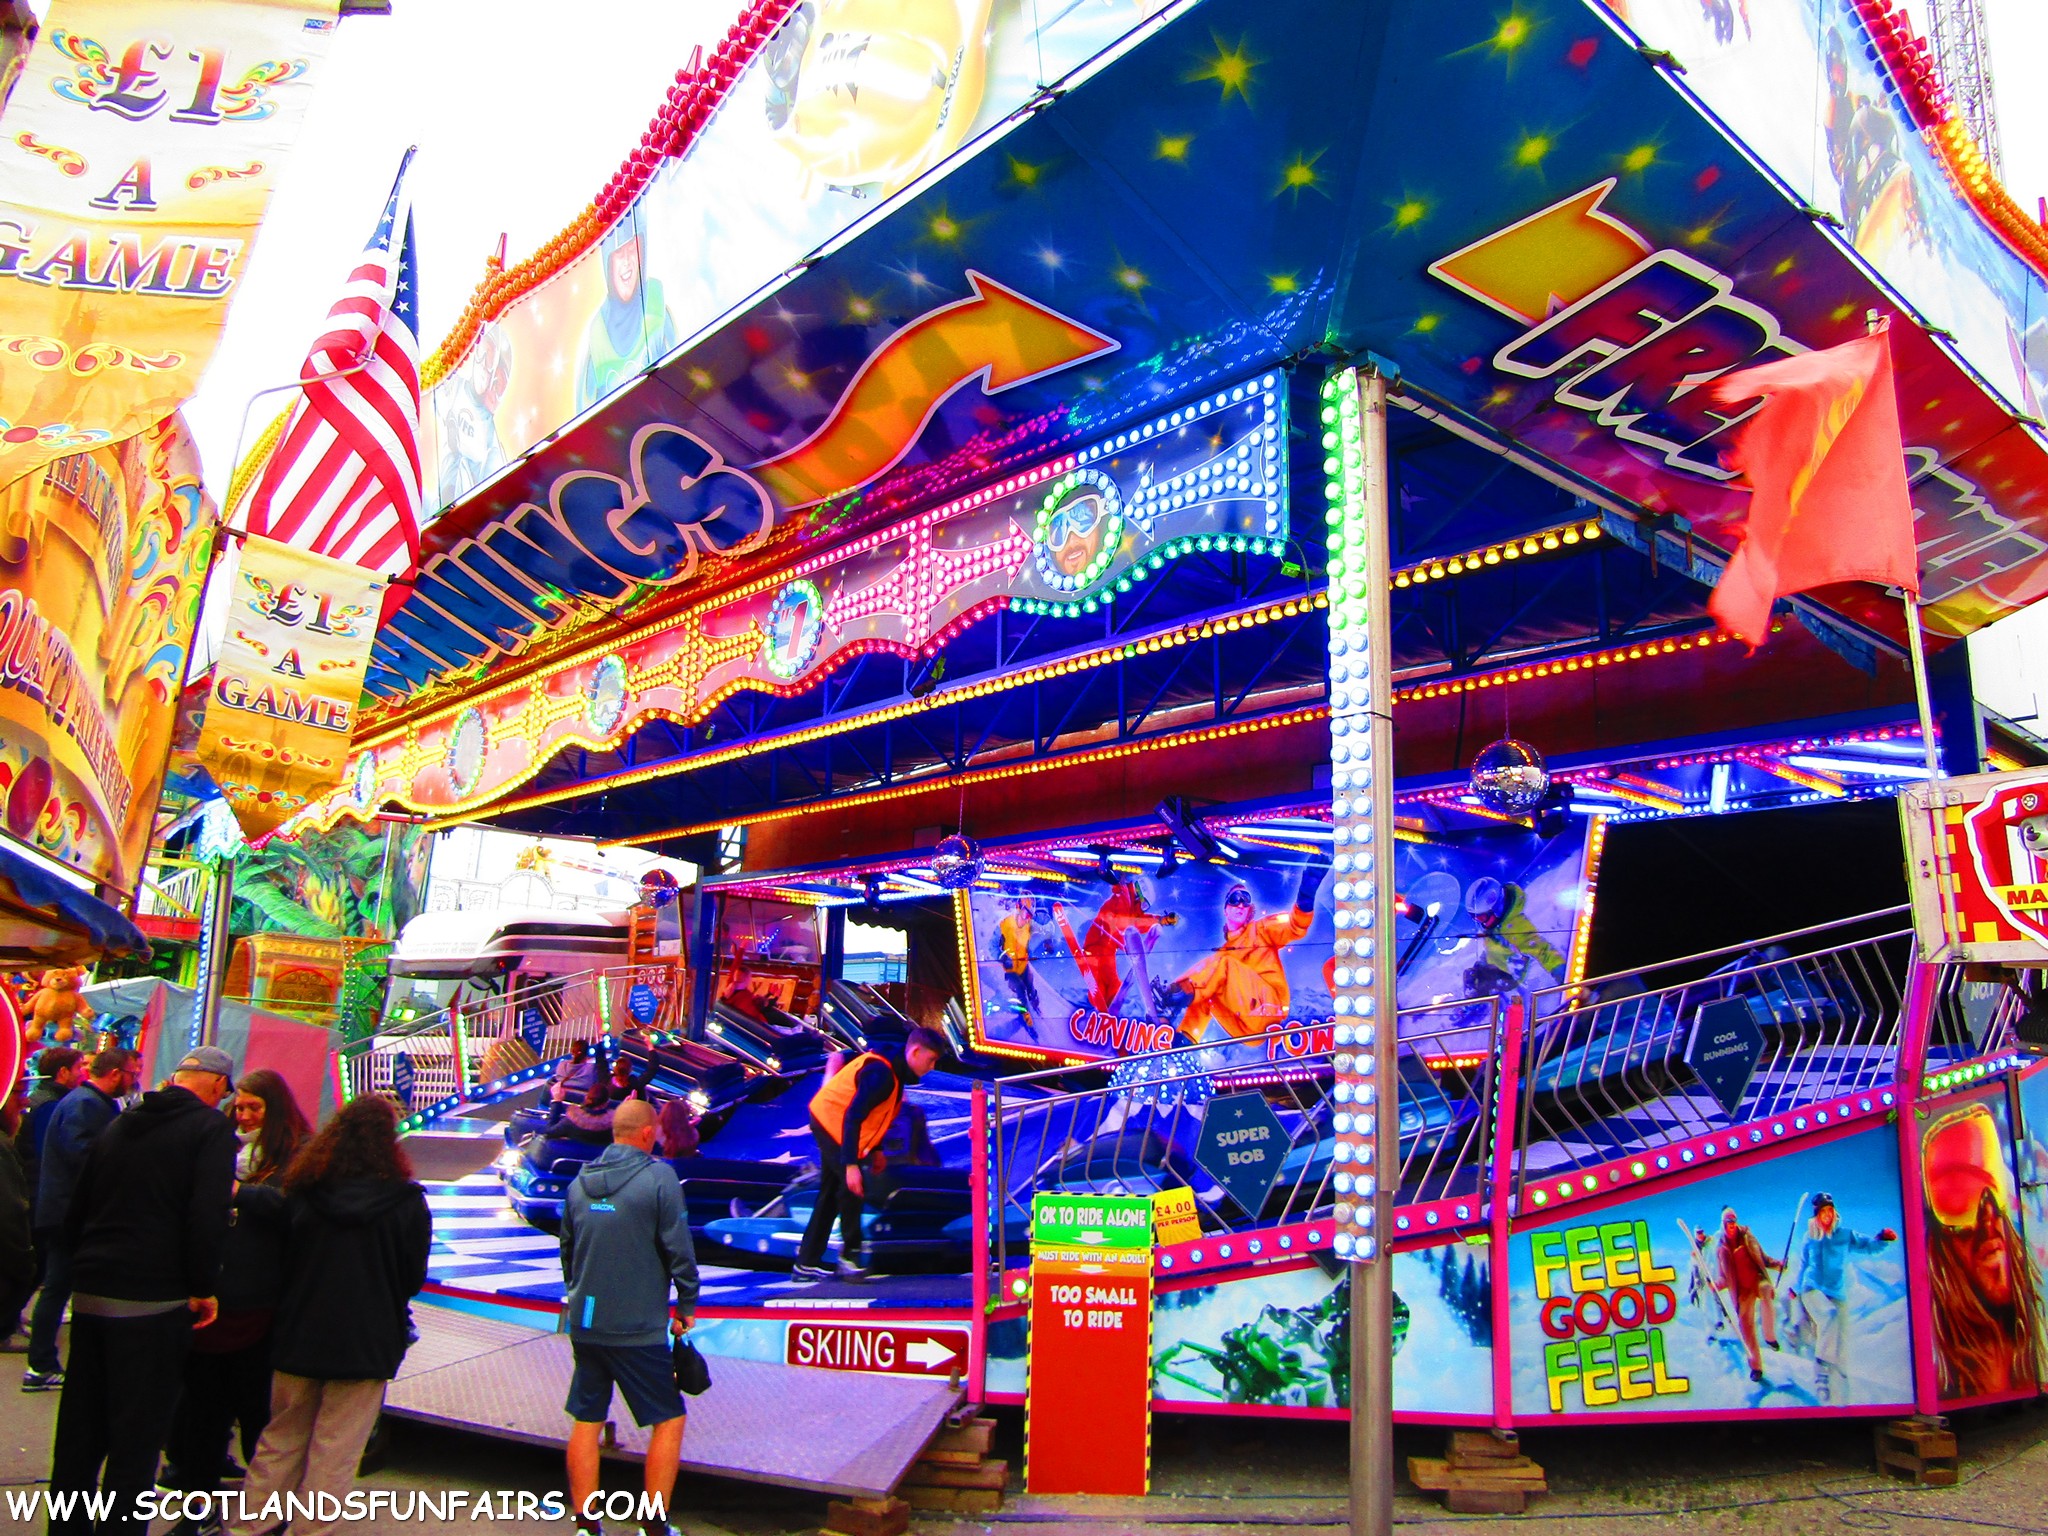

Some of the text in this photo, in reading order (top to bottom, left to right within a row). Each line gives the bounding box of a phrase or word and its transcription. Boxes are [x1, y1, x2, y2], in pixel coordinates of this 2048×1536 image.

[88, 36, 226, 125] £1
[89, 155, 157, 211] A
[0, 220, 244, 300] GAME
[266, 583, 334, 635] £1
[272, 647, 305, 679] A
[215, 675, 352, 732] GAME
[1070, 1008, 1174, 1054] CARVING
[1714, 1031, 1737, 1044] COOL
[1703, 1042, 1749, 1061] RUNNINGS
[1216, 1126, 1270, 1147] SUPER
[1227, 1149, 1265, 1166] BOB
[1040, 1206, 1146, 1227] OK TO RIDE ALONE
[1156, 1201, 1191, 1217] £4.00
[1157, 1215, 1196, 1228] PER PERSON
[1038, 1251, 1146, 1264] MUST RIDE WITH AN ADULT
[1530, 1219, 1676, 1300] FEEL
[1051, 1285, 1137, 1305] TOO SMALL
[1540, 1283, 1676, 1339] GOOD
[1064, 1309, 1123, 1328] TO RIDE
[797, 1328, 895, 1368] SKIING
[1544, 1328, 1689, 1412] FEEL
